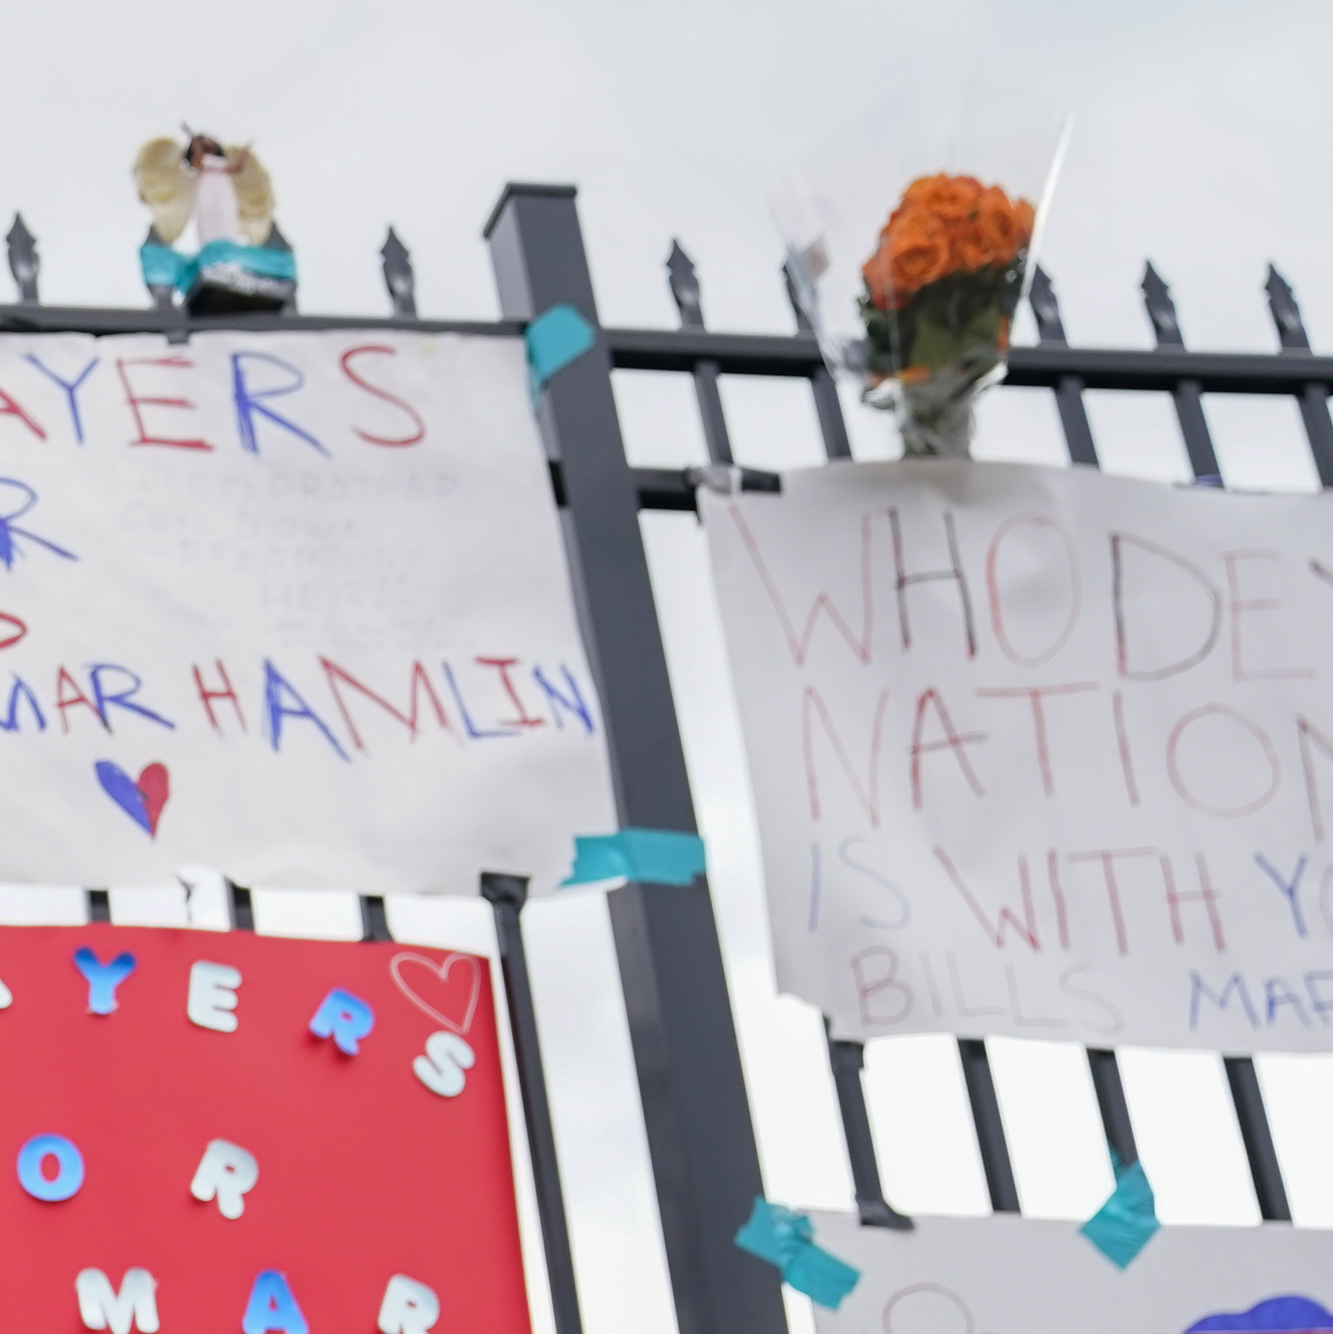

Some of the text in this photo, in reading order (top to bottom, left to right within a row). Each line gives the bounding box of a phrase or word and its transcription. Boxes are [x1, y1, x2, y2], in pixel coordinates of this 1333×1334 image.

[192, 654, 597, 762] HAMLIN
[806, 834, 1333, 957] IS WITH Y
[849, 943, 1124, 1036] BILLS
